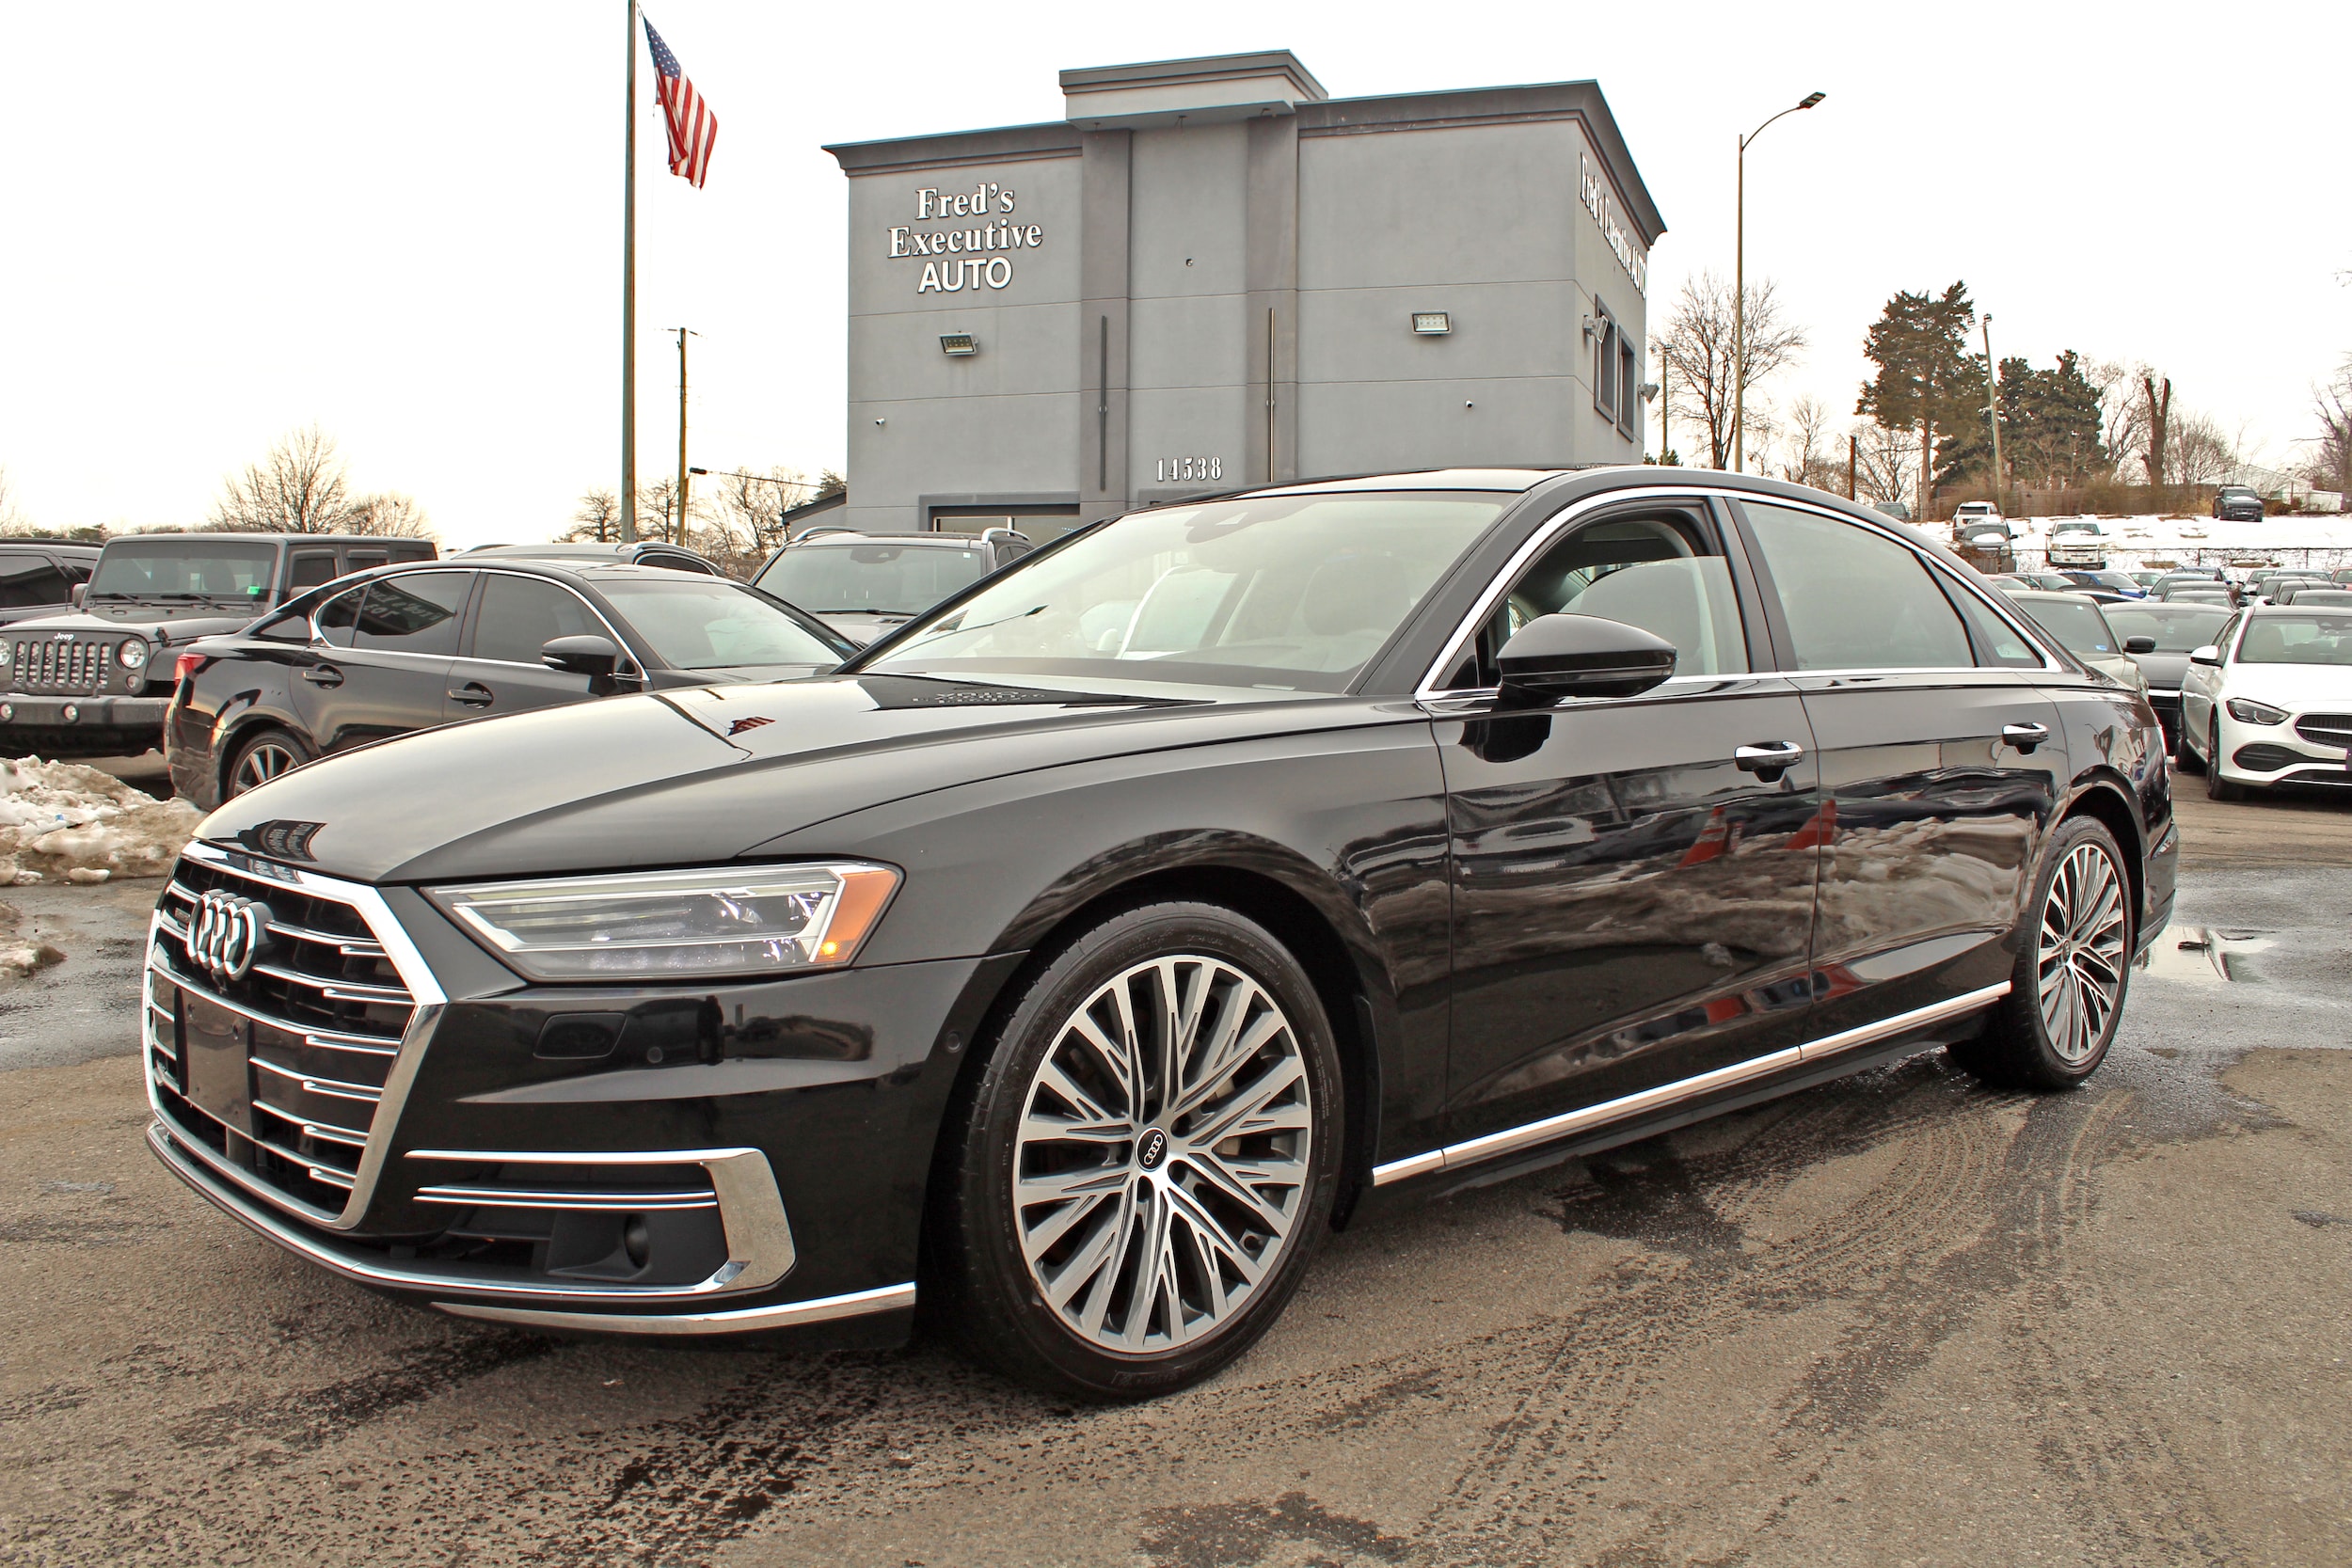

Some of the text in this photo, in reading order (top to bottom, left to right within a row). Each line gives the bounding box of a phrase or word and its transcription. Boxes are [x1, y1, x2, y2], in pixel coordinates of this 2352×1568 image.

[915, 182, 1015, 220] Fred's
[887, 218, 1043, 259] Executive
[1580, 151, 1603, 229] Fred's
[1630, 244, 1646, 300] AUTO
[917, 255, 1013, 293] AUTO
[1156, 456, 1223, 482] 14538
[54, 632, 74, 641] Jeep
